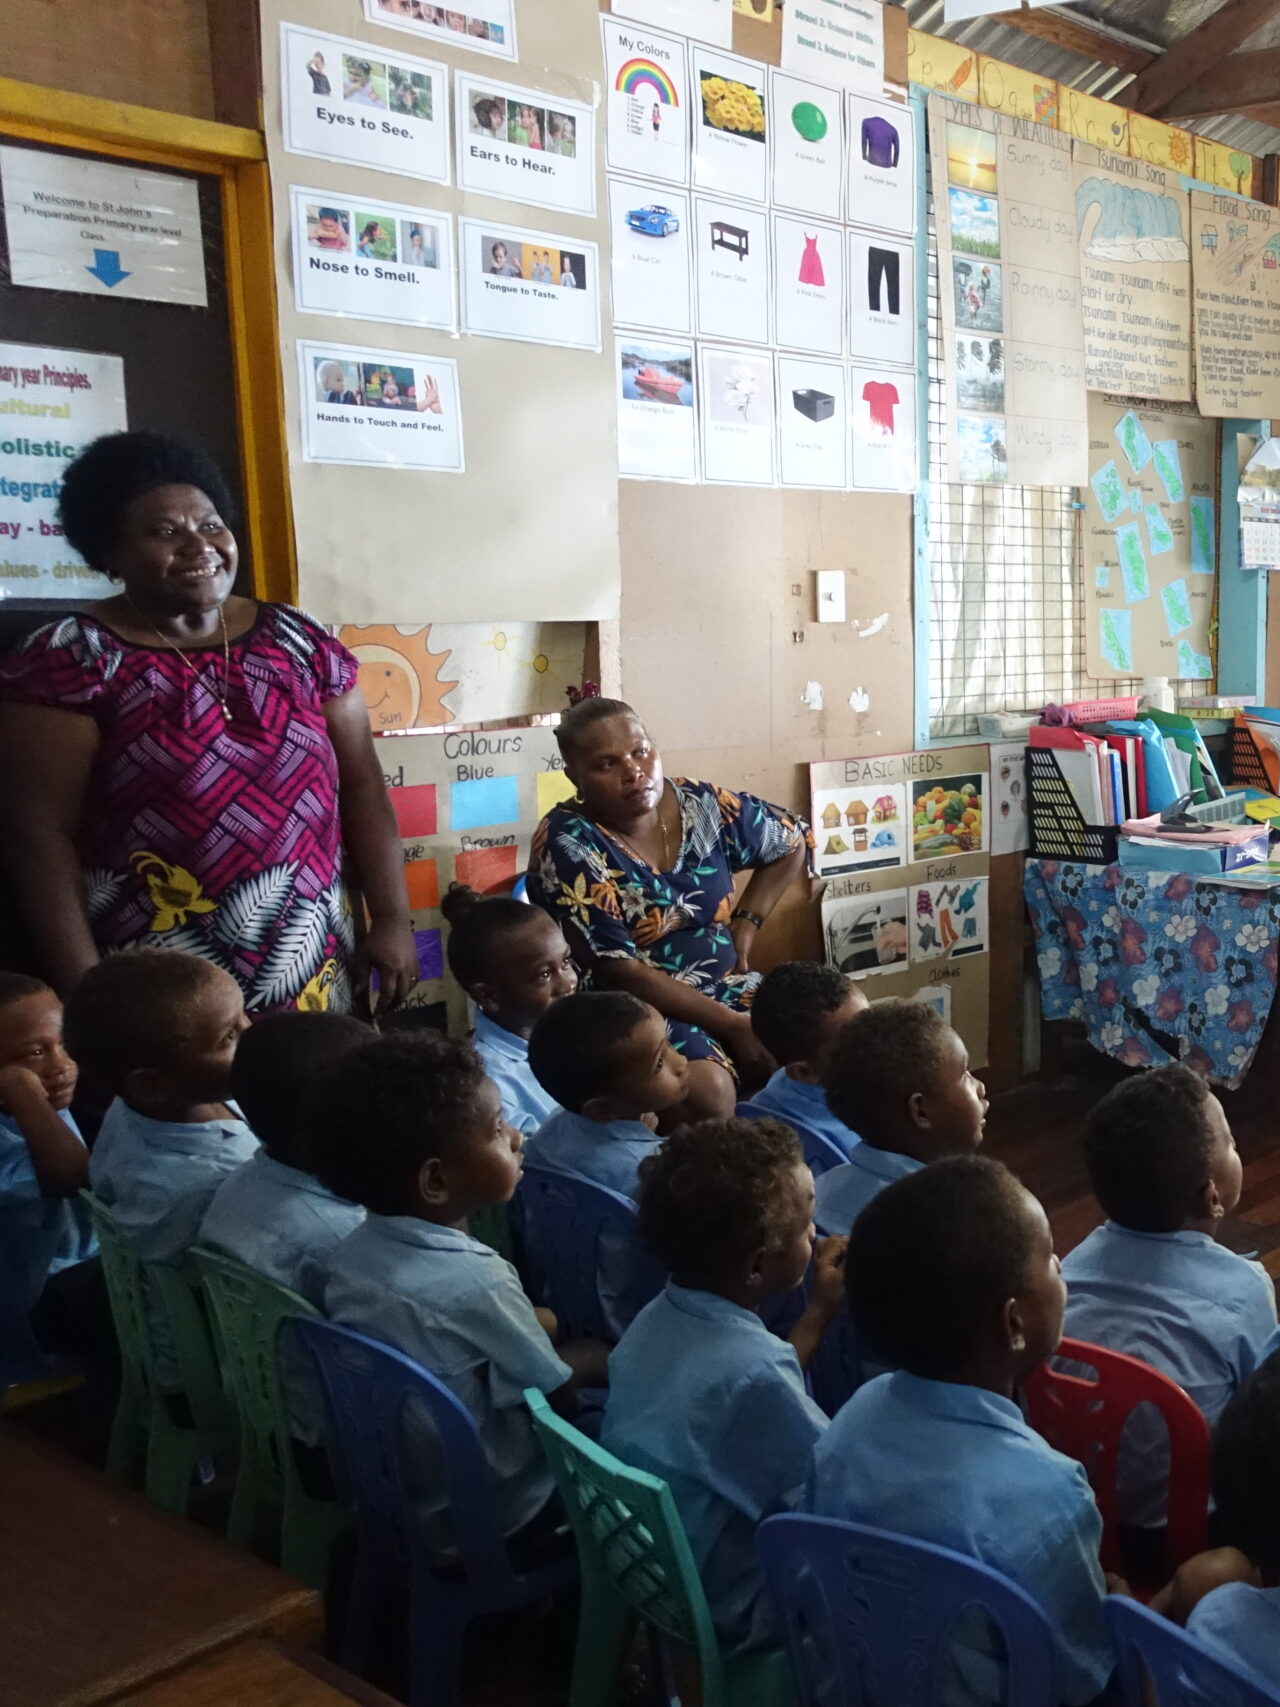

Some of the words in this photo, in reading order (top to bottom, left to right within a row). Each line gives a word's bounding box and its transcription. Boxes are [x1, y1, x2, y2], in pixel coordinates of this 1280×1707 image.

[618, 35, 635, 50] My
[636, 40, 671, 60] Colors
[317, 106, 355, 128] Eyes
[360, 115, 376, 131] to
[381, 120, 414, 140] See.
[470, 145, 500, 164] Ears
[505, 153, 518, 167] to
[522, 157, 556, 176] Hear.
[1006, 143, 1046, 176] Sunny
[1050, 156, 1069, 180] day
[1095, 147, 1139, 178] Tsunami
[33, 191, 86, 210] Welcome
[88, 201, 100, 211] to
[102, 202, 114, 213] St
[1212, 194, 1239, 218] Flood
[1246, 201, 1271, 231] Song
[23, 204, 92, 225] Preparation
[94, 216, 137, 232] Primary
[1009, 207, 1050, 242] Cloudy
[1054, 216, 1073, 243] day
[309, 257, 349, 275] Nose
[354, 263, 369, 278] to
[374, 266, 420, 285] Smell.
[1084, 265, 1115, 283] Tsunami
[484, 281, 518, 295] Tongue
[520, 285, 530, 296] to
[532, 288, 559, 301] Taste.
[1056, 284, 1079, 308] day
[1104, 289, 1116, 302] for
[1116, 288, 1133, 310] dry
[1083, 305, 1117, 321] Tsunami
[0, 366, 18, 388] ary
[20, 367, 41, 389] year
[1013, 352, 1055, 381] Stormy
[1103, 395, 1147, 409] SOLOMON
[316, 412, 350, 424] Hands
[354, 416, 364, 425] to
[367, 417, 398, 429] Touch
[400, 420, 419, 430] and
[421, 422, 444, 432] Feel.
[1016, 424, 1051, 454] Windy
[0, 476, 64, 503] tegrat
[378, 712, 403, 726] Sun
[443, 731, 523, 760] Colours
[383, 766, 404, 787] ed
[457, 764, 494, 782] Blue
[844, 760, 895, 783] BASIC
[902, 754, 943, 775] NEEDS
[461, 834, 515, 853] Brown
[926, 864, 957, 881] Foods
[826, 881, 872, 899] Shelters
